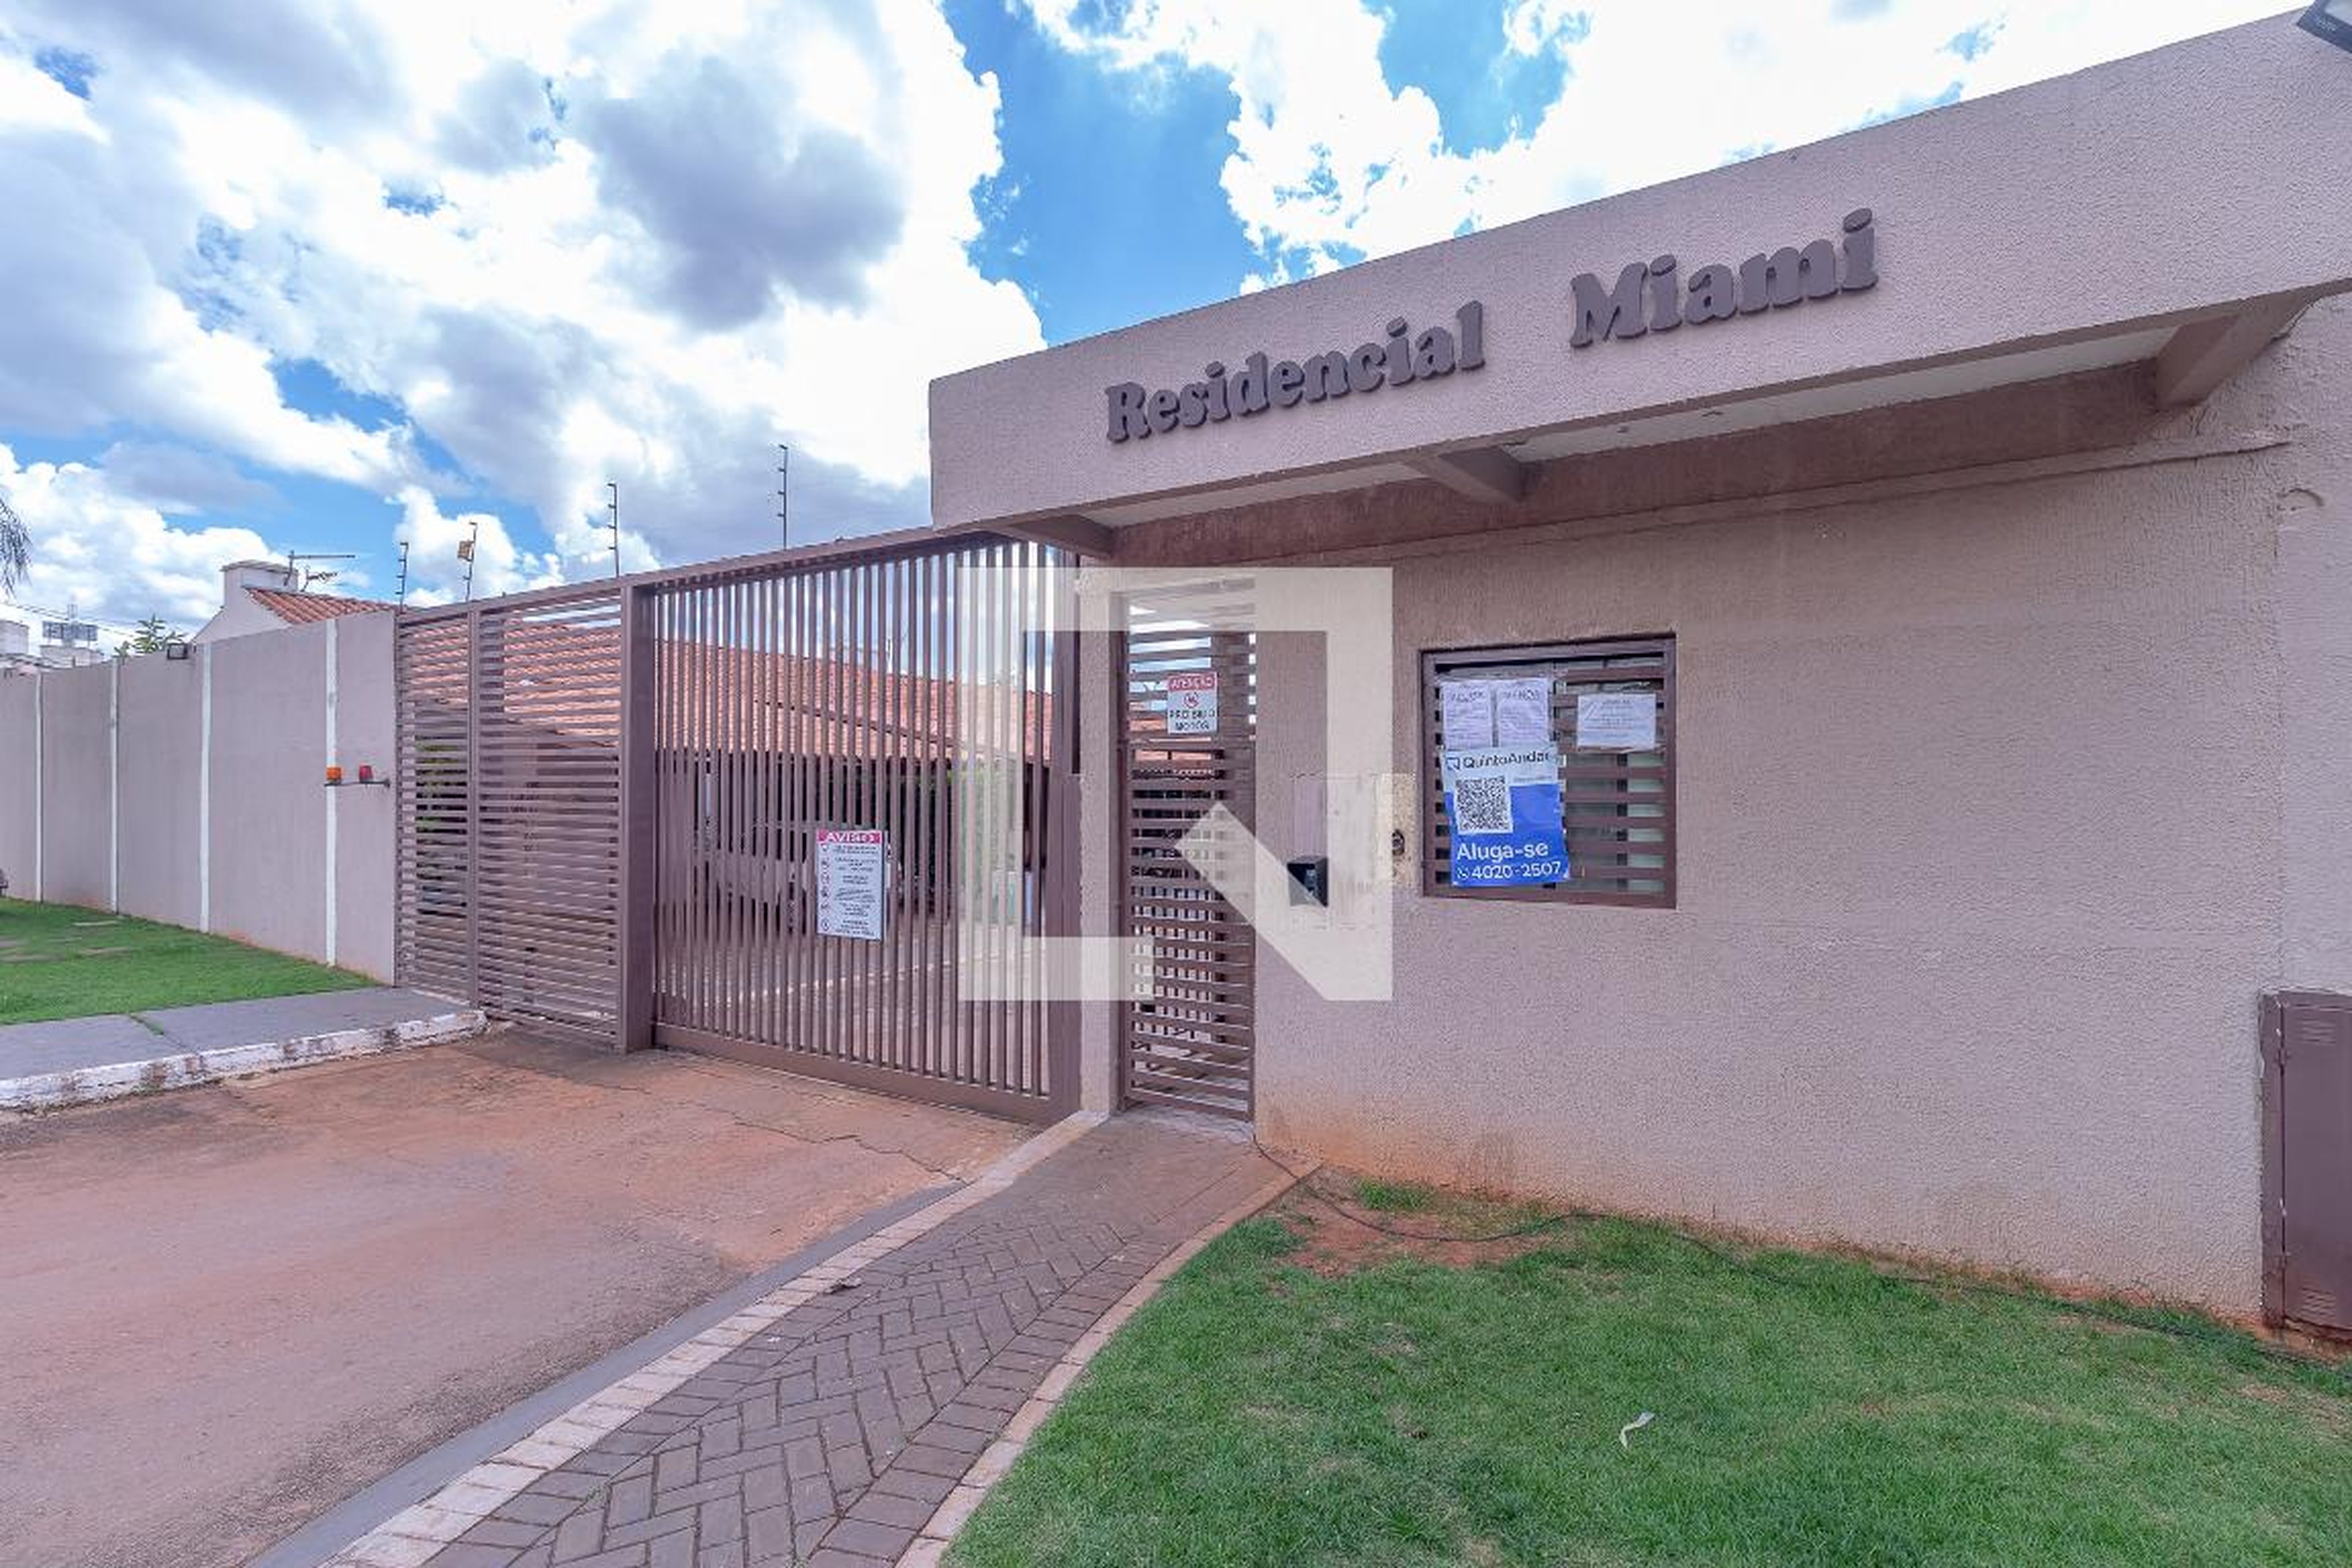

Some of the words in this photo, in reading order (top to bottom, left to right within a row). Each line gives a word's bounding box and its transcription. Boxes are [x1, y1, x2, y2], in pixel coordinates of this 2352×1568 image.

[1105, 300, 1486, 443] Residencial
[1570, 208, 1879, 348] Miami
[1457, 842, 1549, 864] Aluga-se
